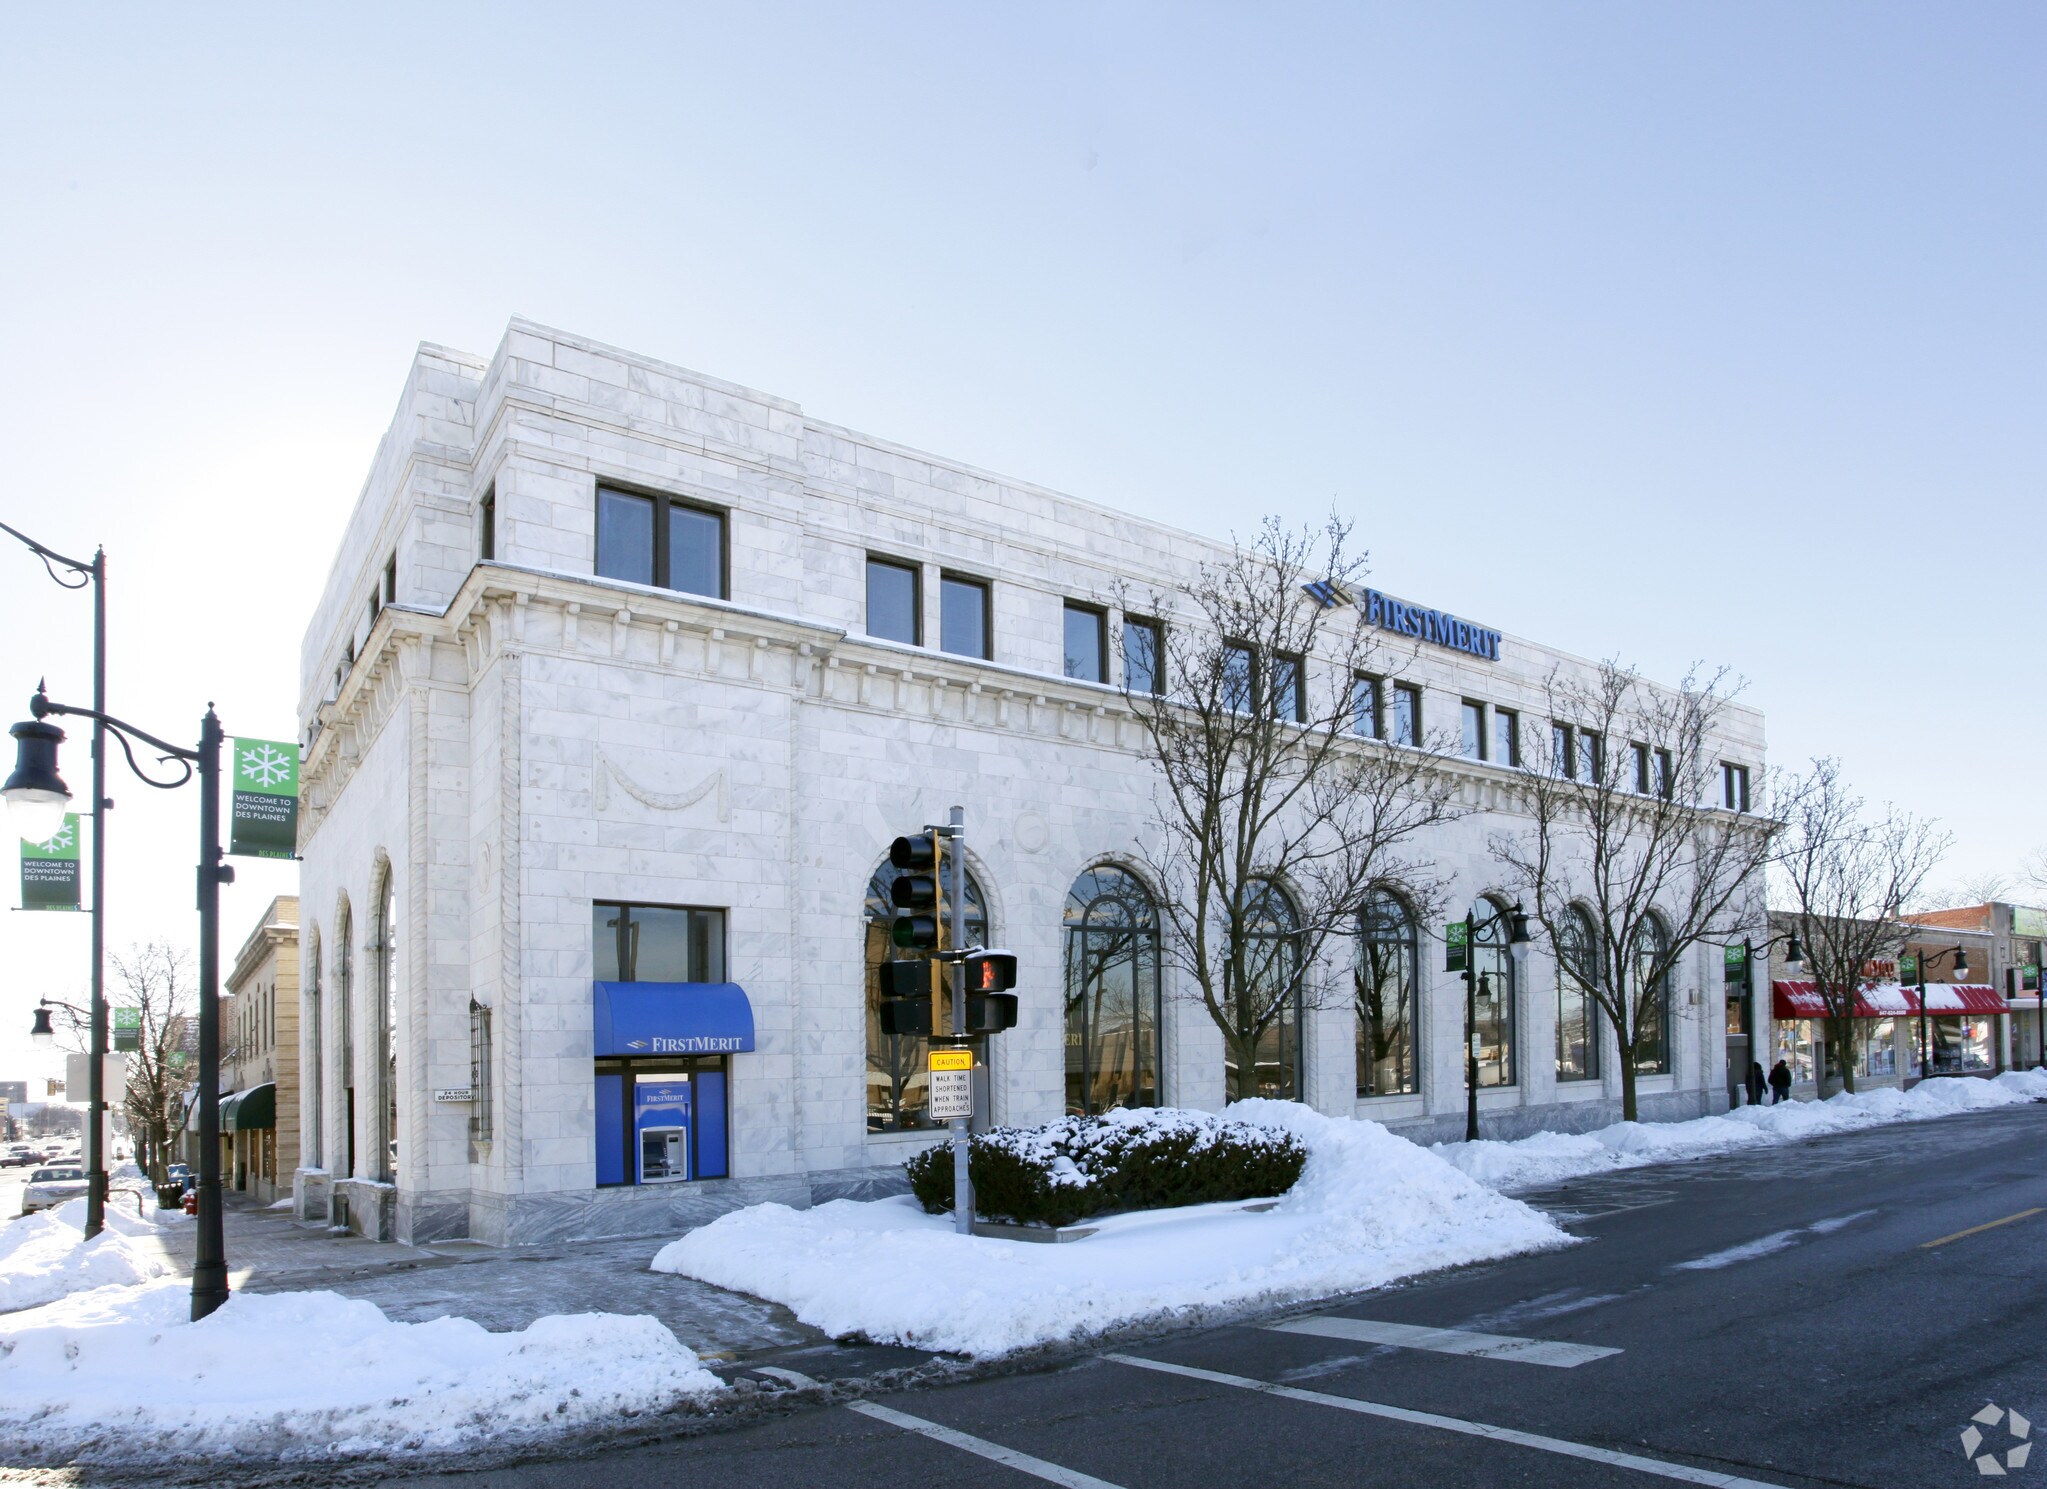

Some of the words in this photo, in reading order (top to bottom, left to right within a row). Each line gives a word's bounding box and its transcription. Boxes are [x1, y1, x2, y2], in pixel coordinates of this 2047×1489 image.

[236, 795, 278, 805] WELCOME
[236, 802, 290, 814] DOWNTOWN
[235, 811, 252, 819] DES
[253, 813, 286, 821] PLAINES
